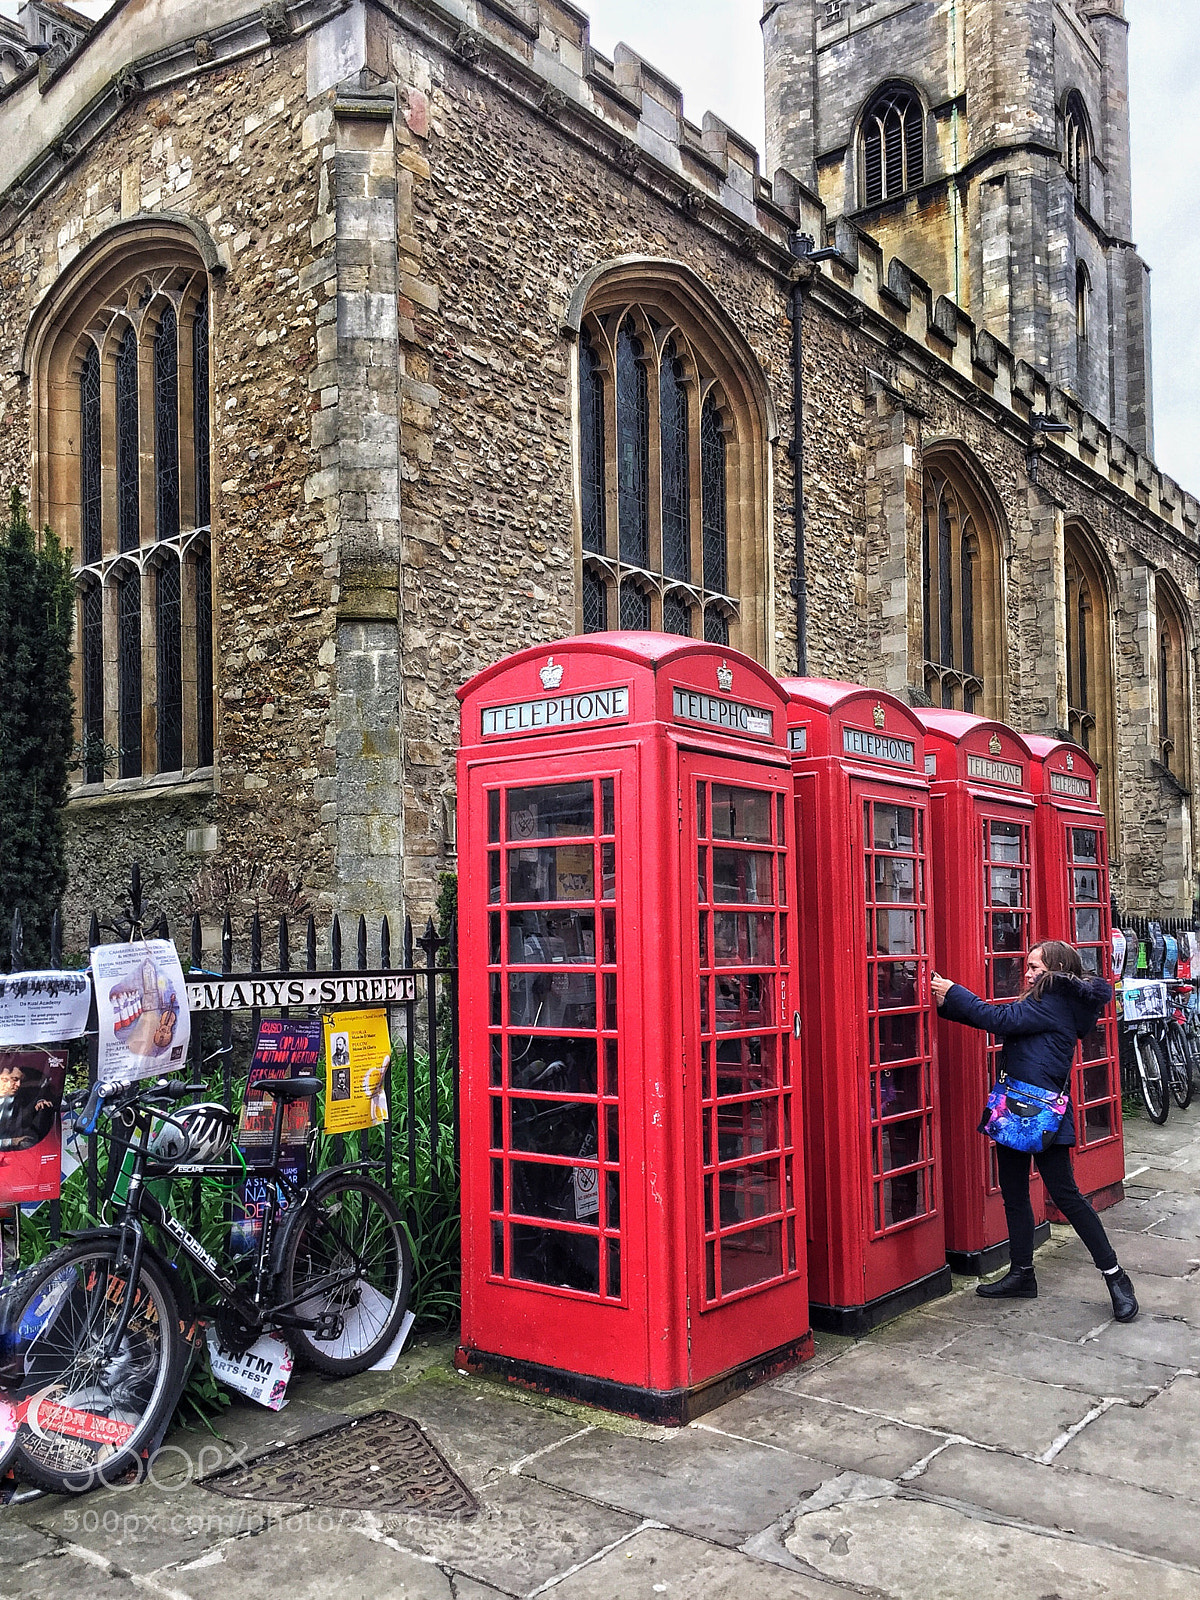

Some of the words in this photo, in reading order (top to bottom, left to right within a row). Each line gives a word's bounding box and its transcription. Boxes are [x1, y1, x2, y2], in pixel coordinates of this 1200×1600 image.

[488, 690, 625, 732] TELEPHONE
[844, 731, 911, 762] TELEPHONE
[969, 757, 1019, 784] TELEPHONE
[1051, 774, 1089, 796] TELEPHONE
[203, 982, 305, 1009] MARYS
[320, 976, 411, 1003] STREET
[280, 1036, 309, 1050] COPLAND
[168, 1217, 218, 1271] PROBIKE
[212, 1360, 240, 1375] ARTS
[241, 1369, 268, 1385] FEST
